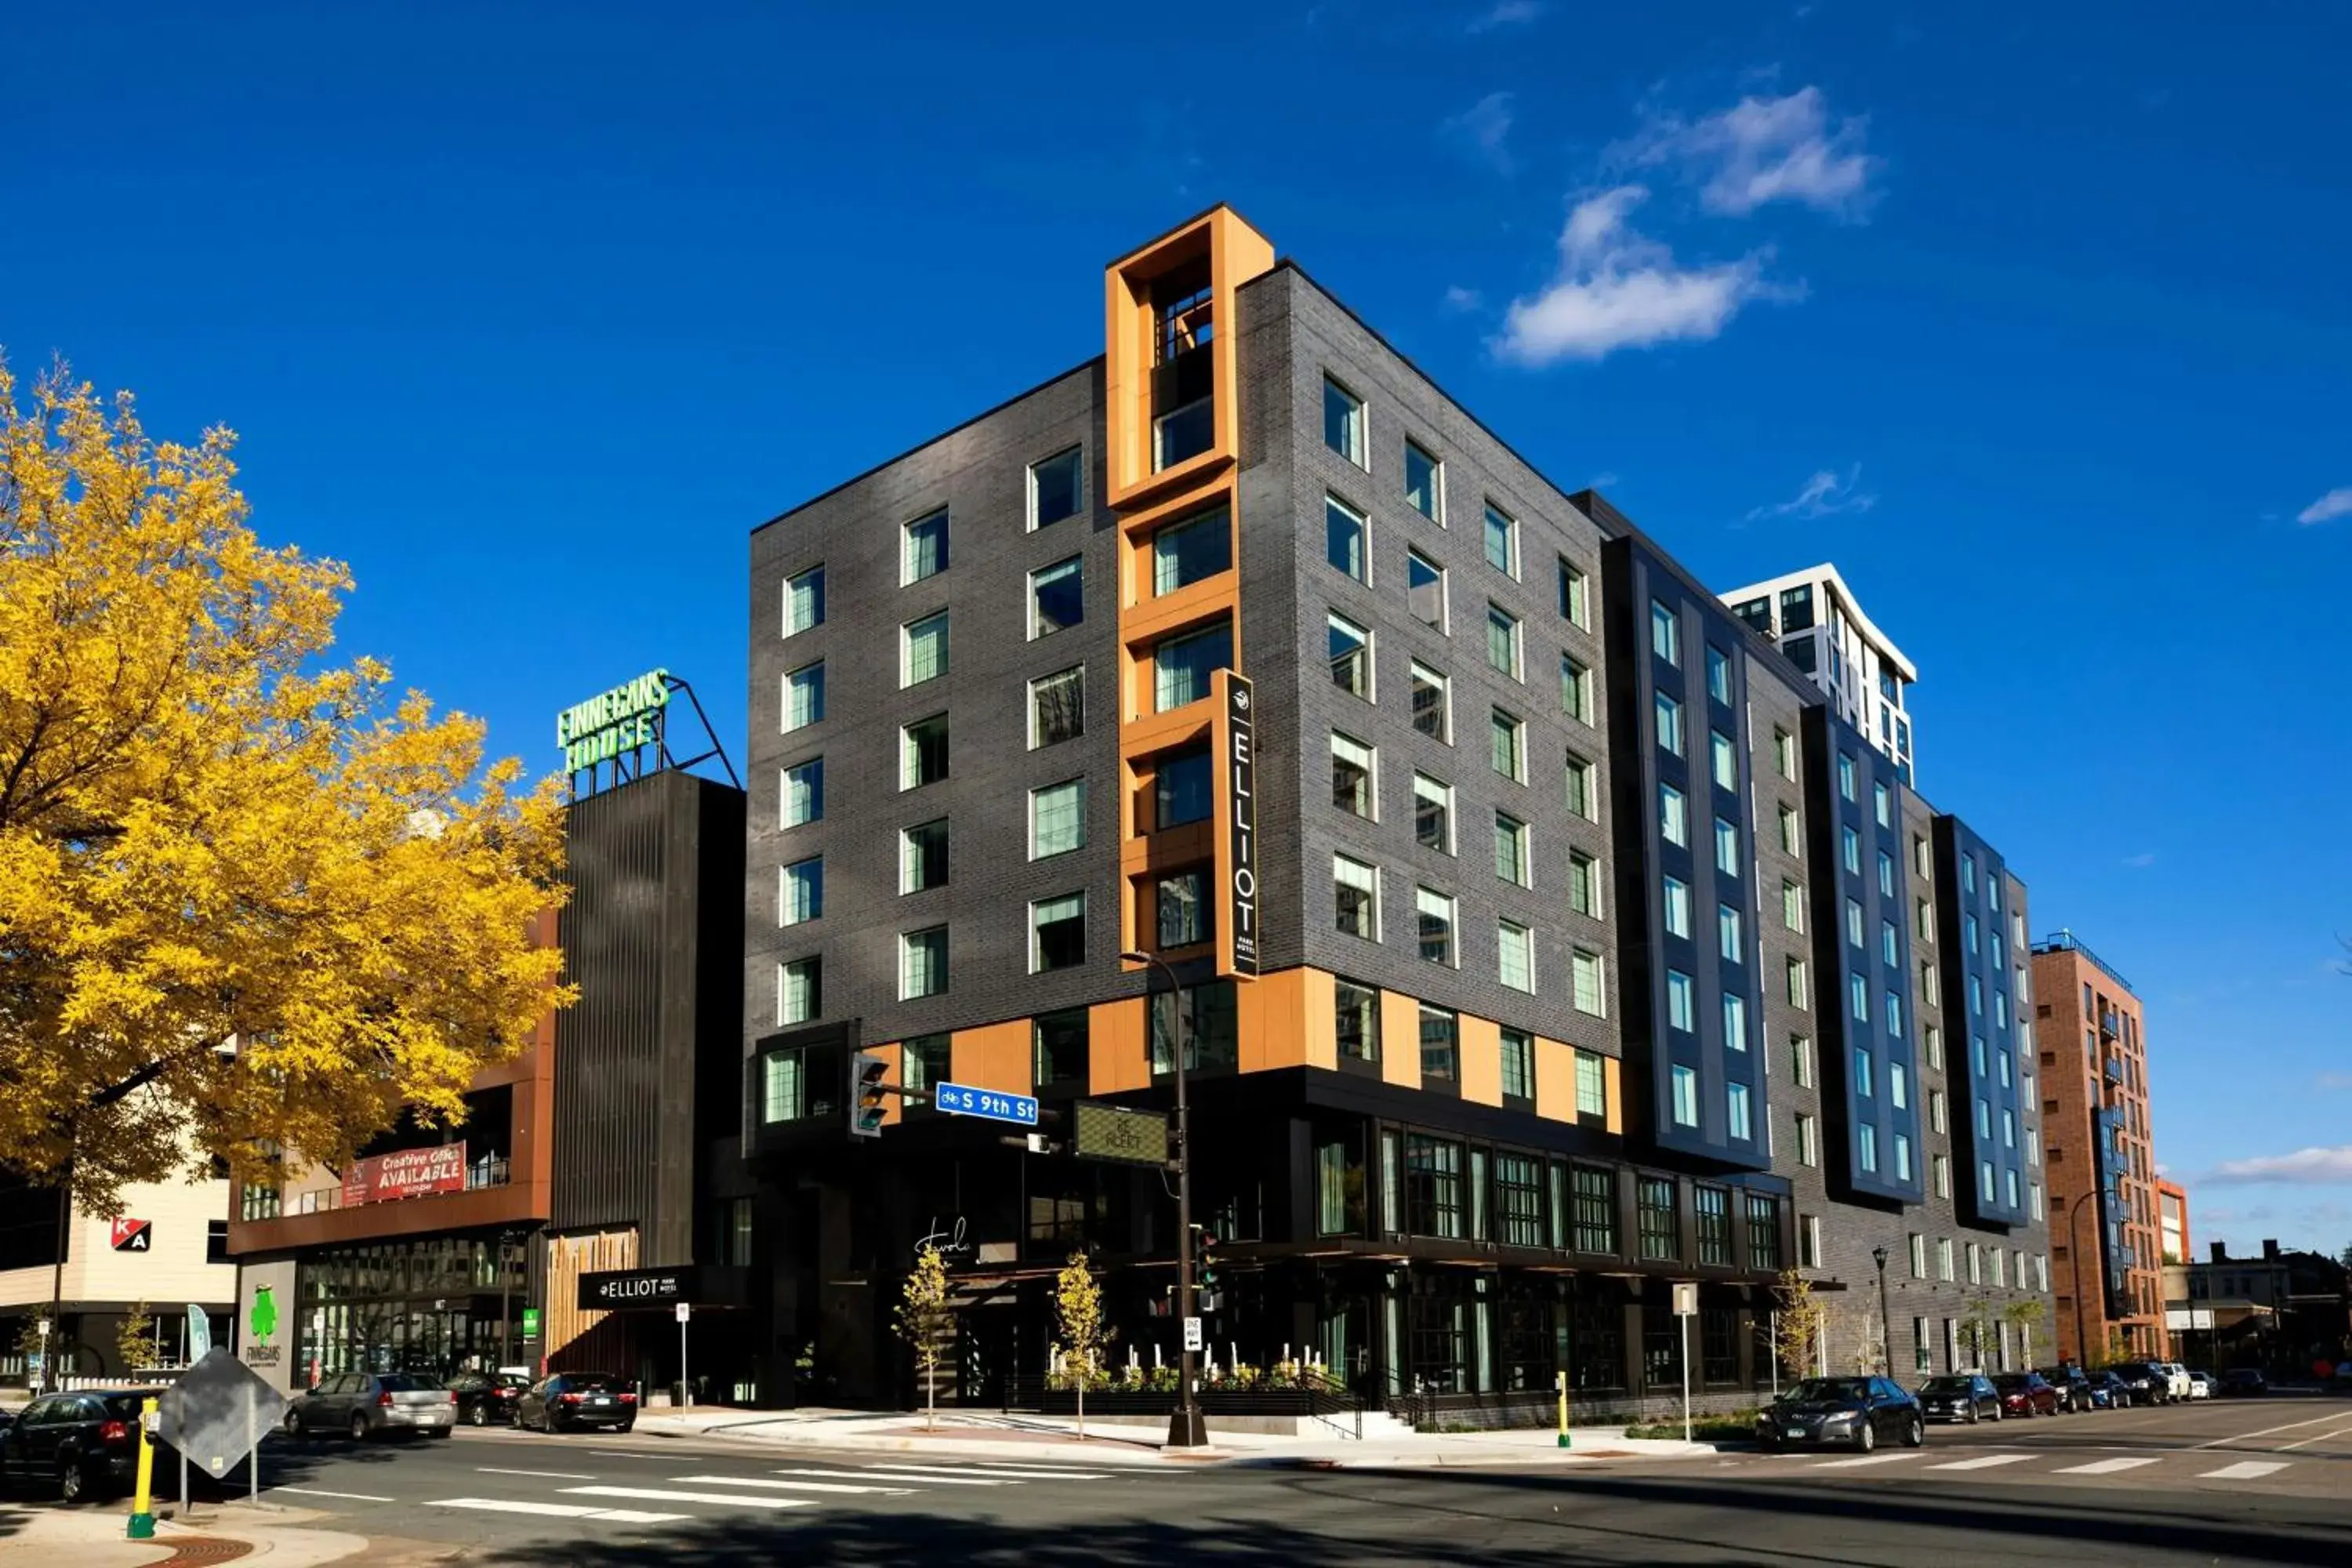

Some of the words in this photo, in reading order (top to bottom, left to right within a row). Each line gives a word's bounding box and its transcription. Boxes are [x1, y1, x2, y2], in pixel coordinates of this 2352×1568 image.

[557, 668, 669, 749] FINNEGANS
[565, 713, 652, 774] HOUSE
[1235, 731, 1254, 931] ELLIOT
[963, 1092, 973, 1109] S
[981, 1095, 1010, 1114] 9th
[1017, 1102, 1034, 1119] St
[379, 1161, 460, 1189] AVAILABLE
[382, 1153, 427, 1170] Creative
[117, 1221, 130, 1235] K
[132, 1234, 147, 1248] A
[609, 1279, 659, 1298] ELLIOT
